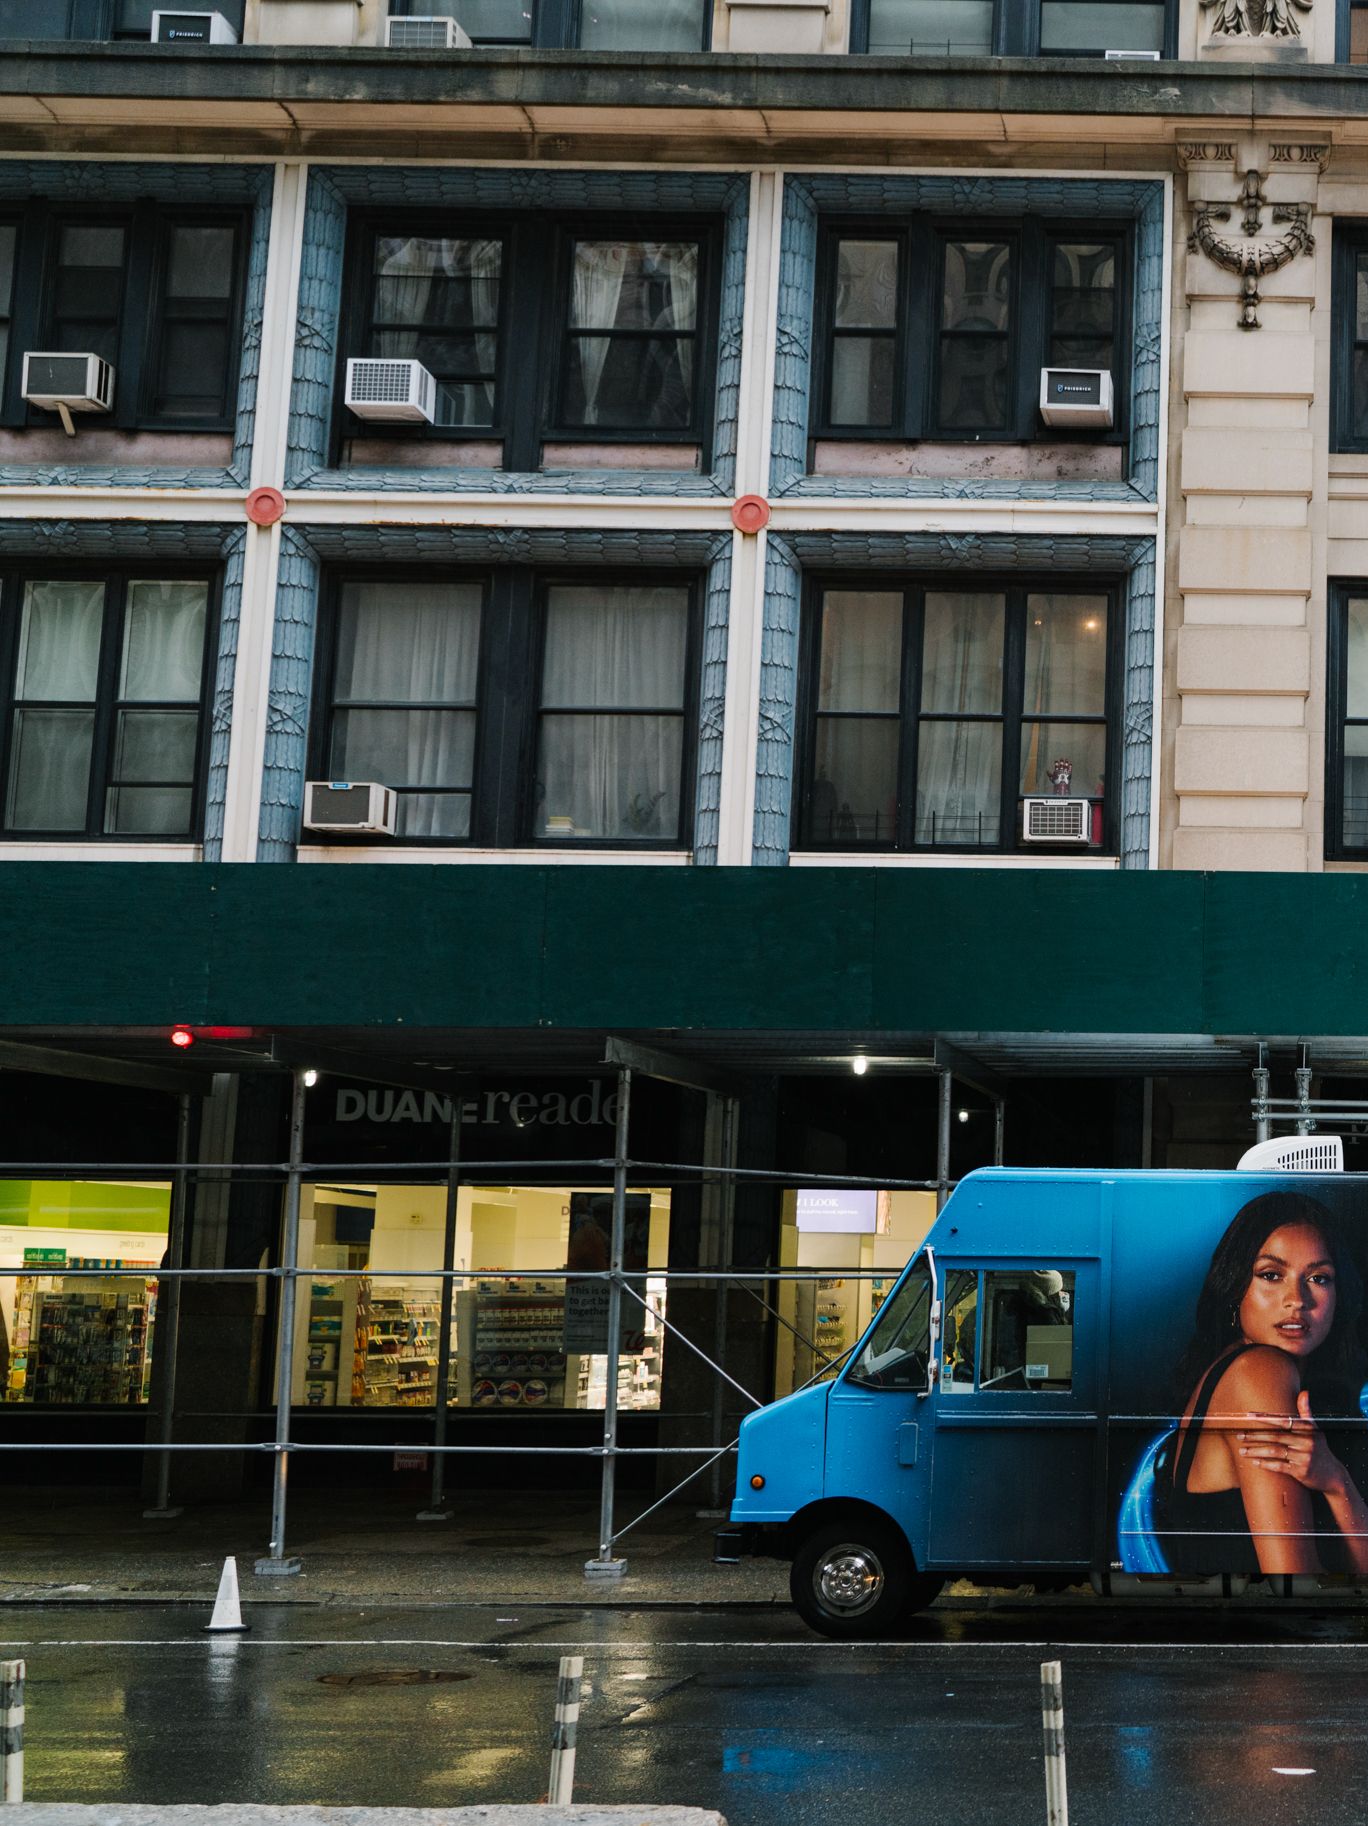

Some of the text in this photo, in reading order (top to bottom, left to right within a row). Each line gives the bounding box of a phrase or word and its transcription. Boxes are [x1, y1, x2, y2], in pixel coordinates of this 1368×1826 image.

[480, 1079, 619, 1125] reade
[570, 1286, 589, 1295] This
[569, 1297, 579, 1305] to
